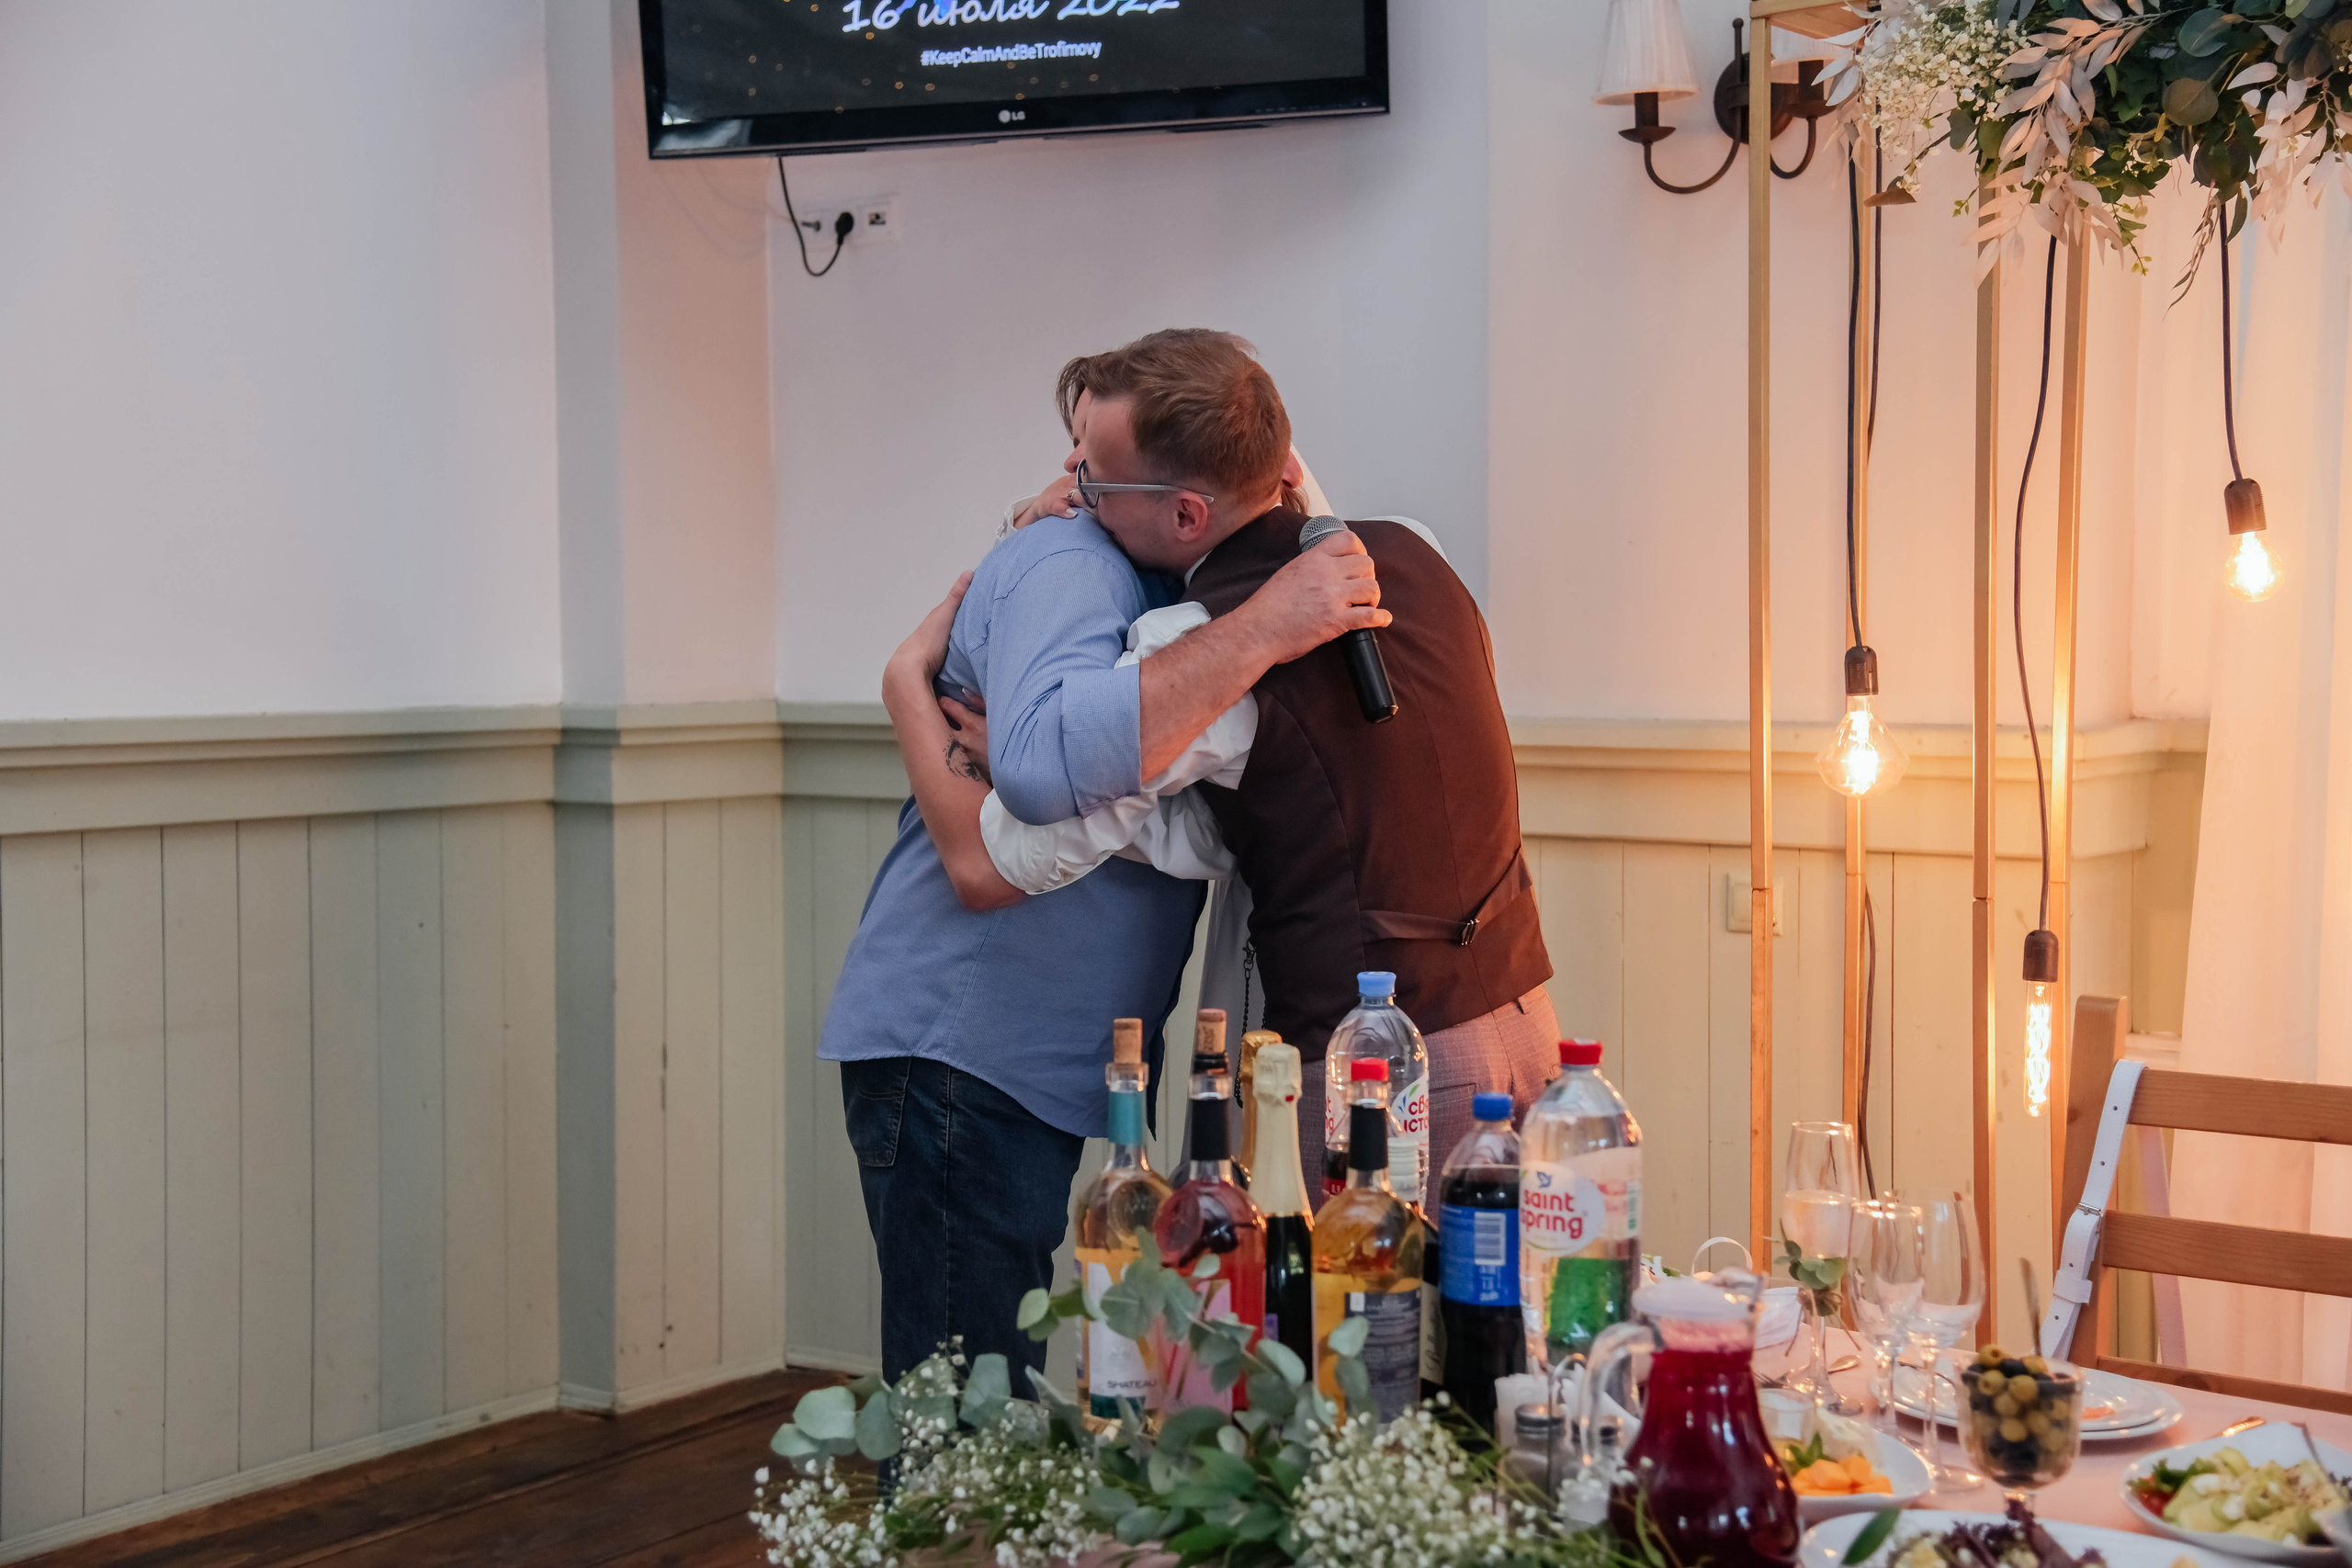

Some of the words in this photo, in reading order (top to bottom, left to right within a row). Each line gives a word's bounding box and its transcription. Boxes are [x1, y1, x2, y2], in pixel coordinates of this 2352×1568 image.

[842, 0, 900, 32] 16
[918, 0, 1050, 28] июля
[921, 40, 1102, 68] #KeepCalmAndBeTrofimovy
[1012, 110, 1026, 120] LG
[1523, 1189, 1575, 1213] saint
